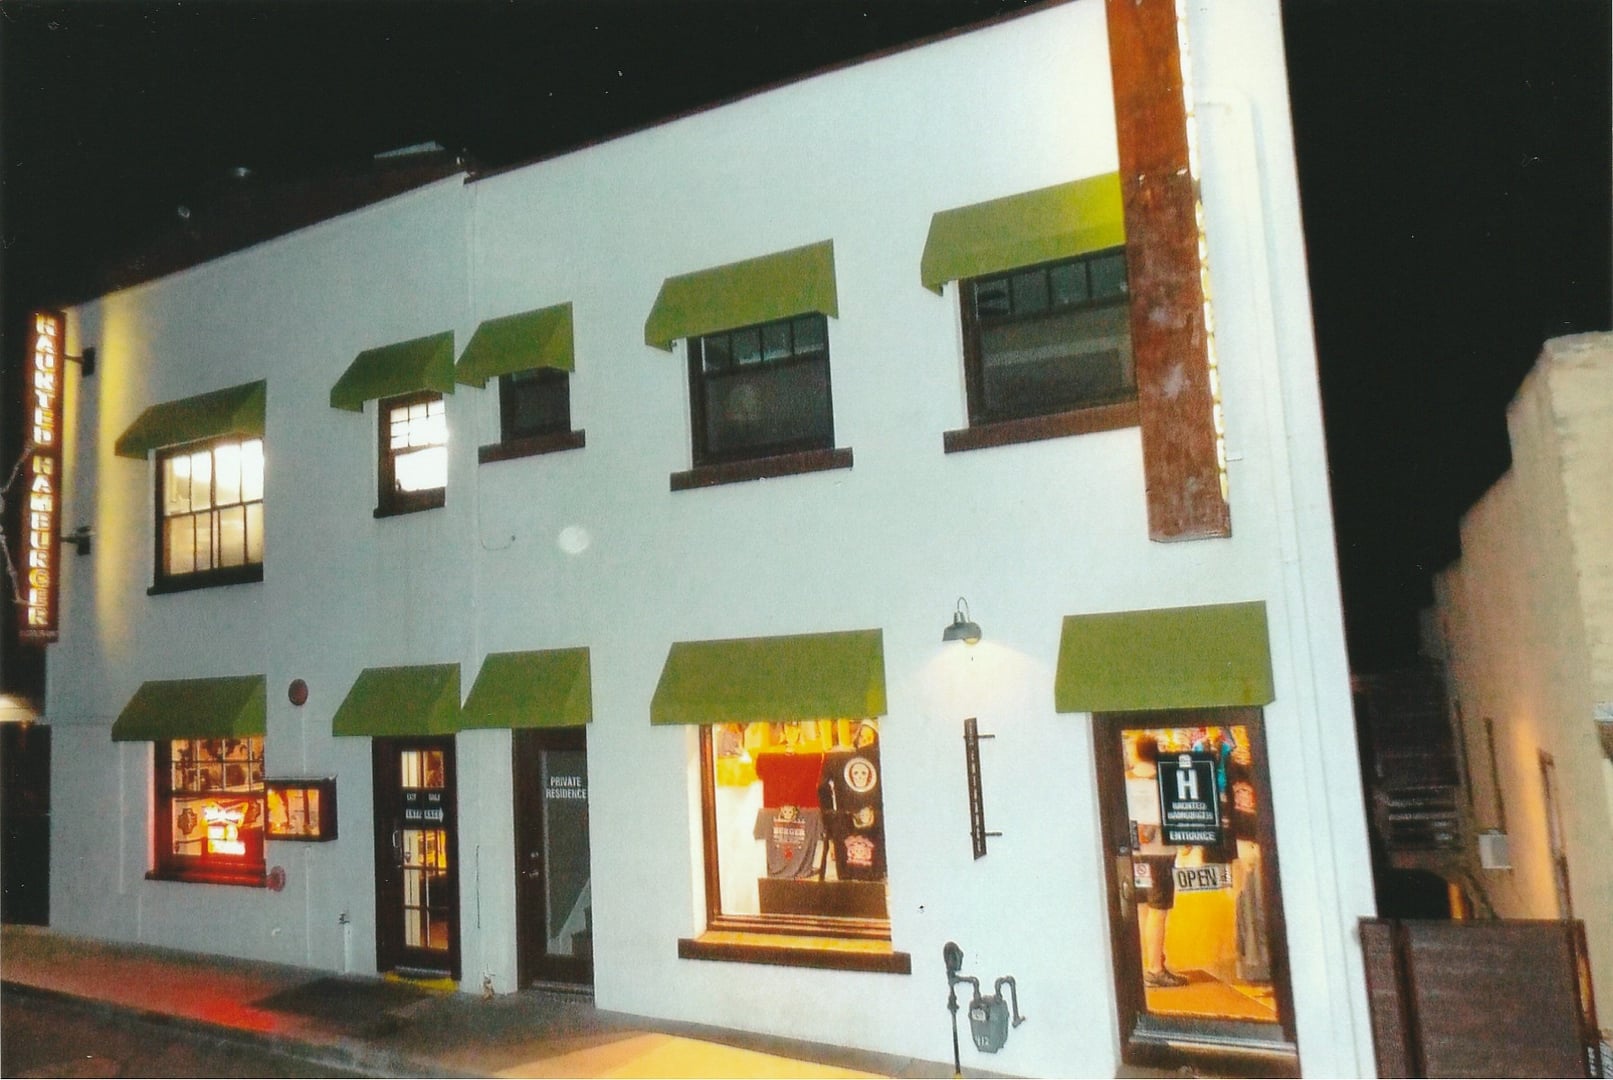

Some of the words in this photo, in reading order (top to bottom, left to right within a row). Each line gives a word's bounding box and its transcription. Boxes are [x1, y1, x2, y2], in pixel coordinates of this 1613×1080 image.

[34, 313, 57, 444] HAUNTED
[27, 455, 53, 625] HAMBURGER
[550, 775, 582, 787] PRIVATE
[1176, 768, 1200, 800] H
[545, 787, 587, 799] RESIDENCE
[1169, 830, 1217, 842] ENTRANCE
[1177, 867, 1218, 888] OPEN
